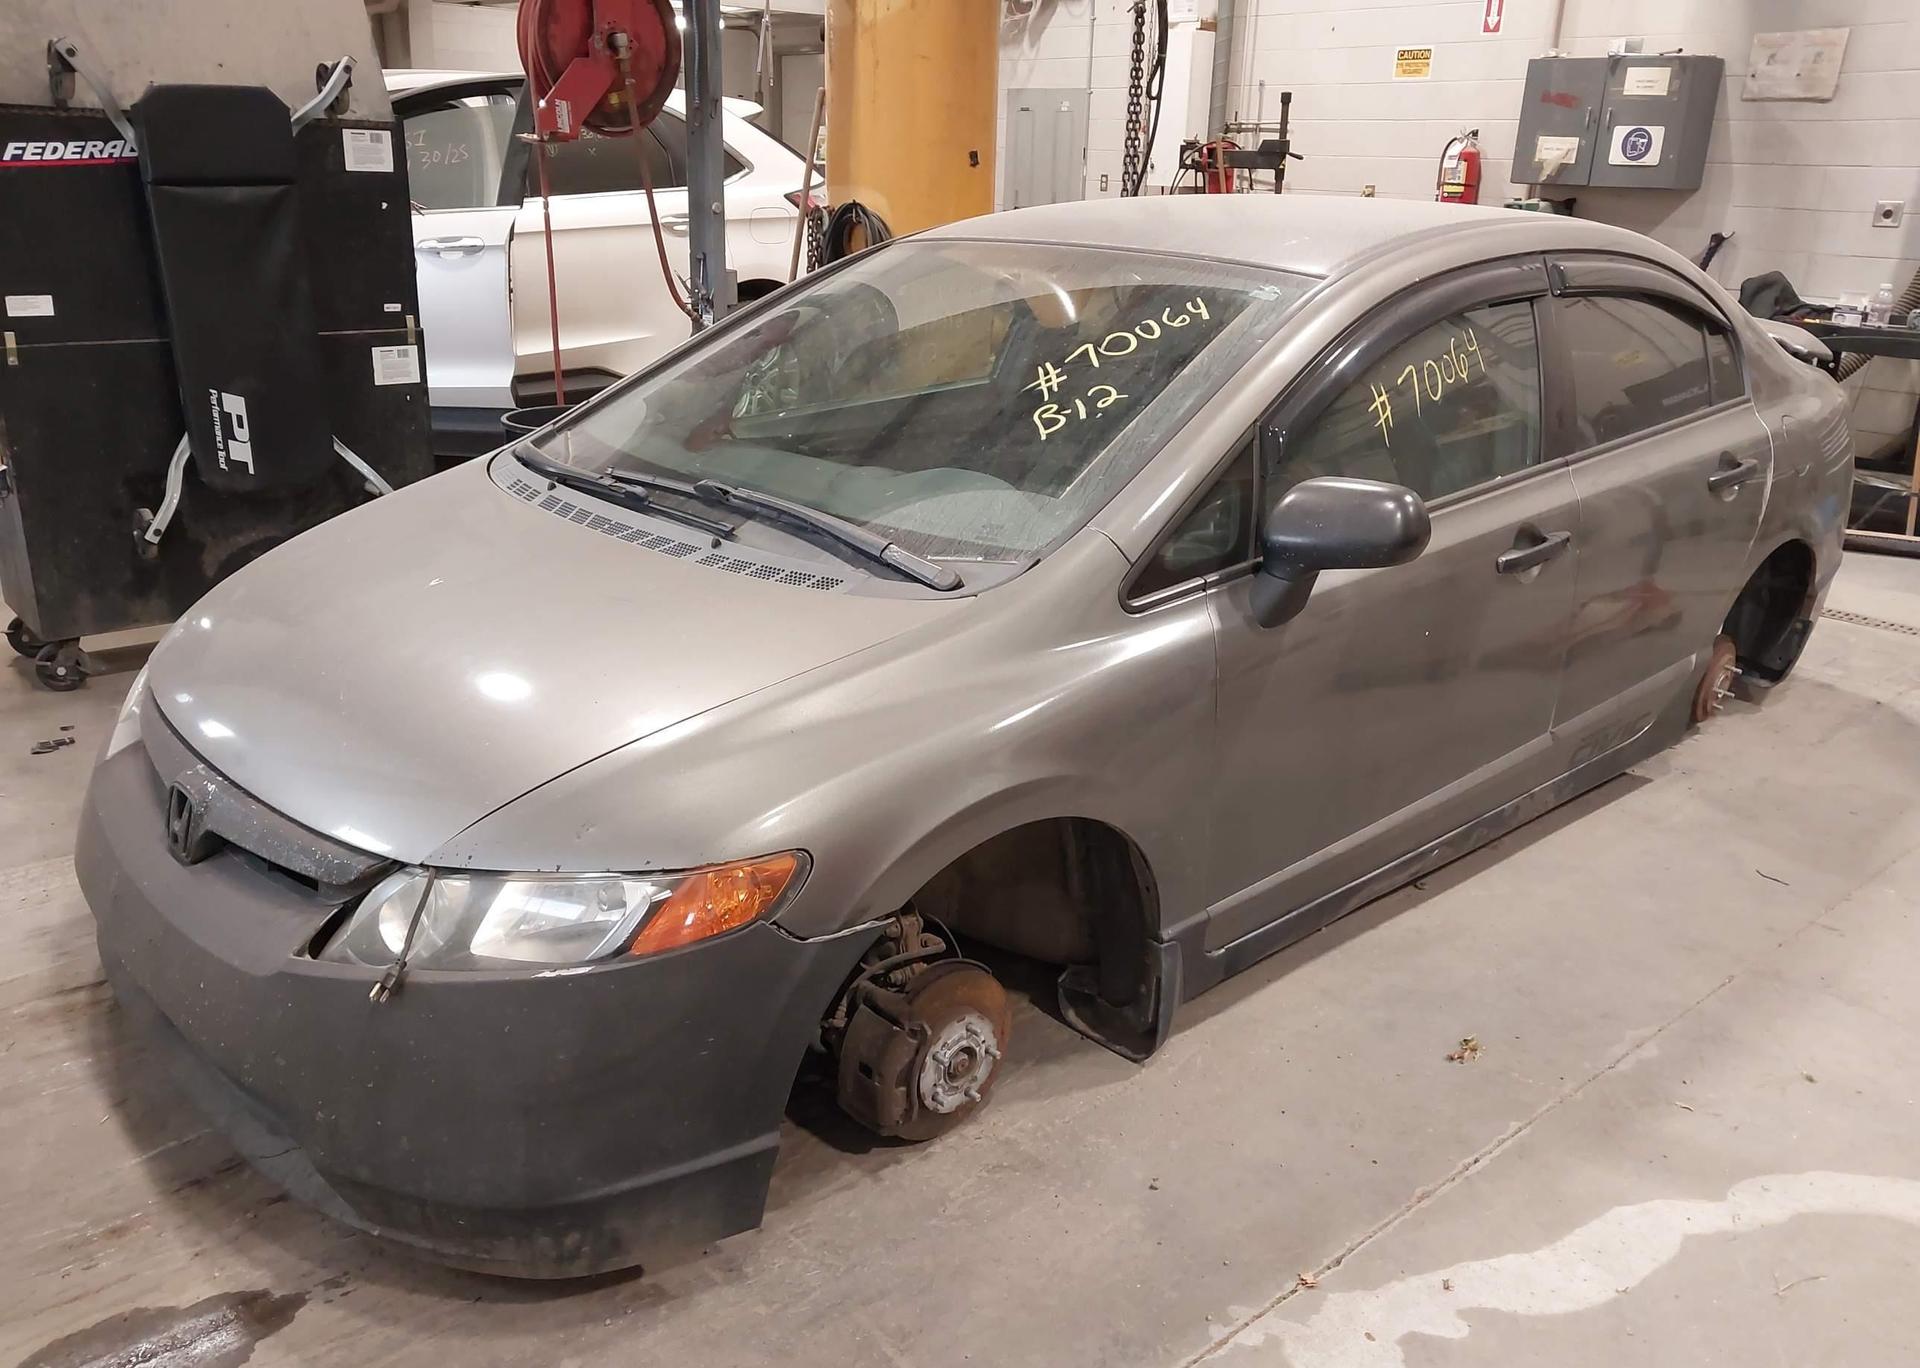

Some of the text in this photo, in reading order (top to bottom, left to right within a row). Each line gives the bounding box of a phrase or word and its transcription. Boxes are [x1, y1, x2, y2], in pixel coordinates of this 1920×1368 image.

[1398, 50, 1431, 60] CAUTION
[209, 388, 229, 472] Performance Tool
[221, 392, 255, 475] PT
